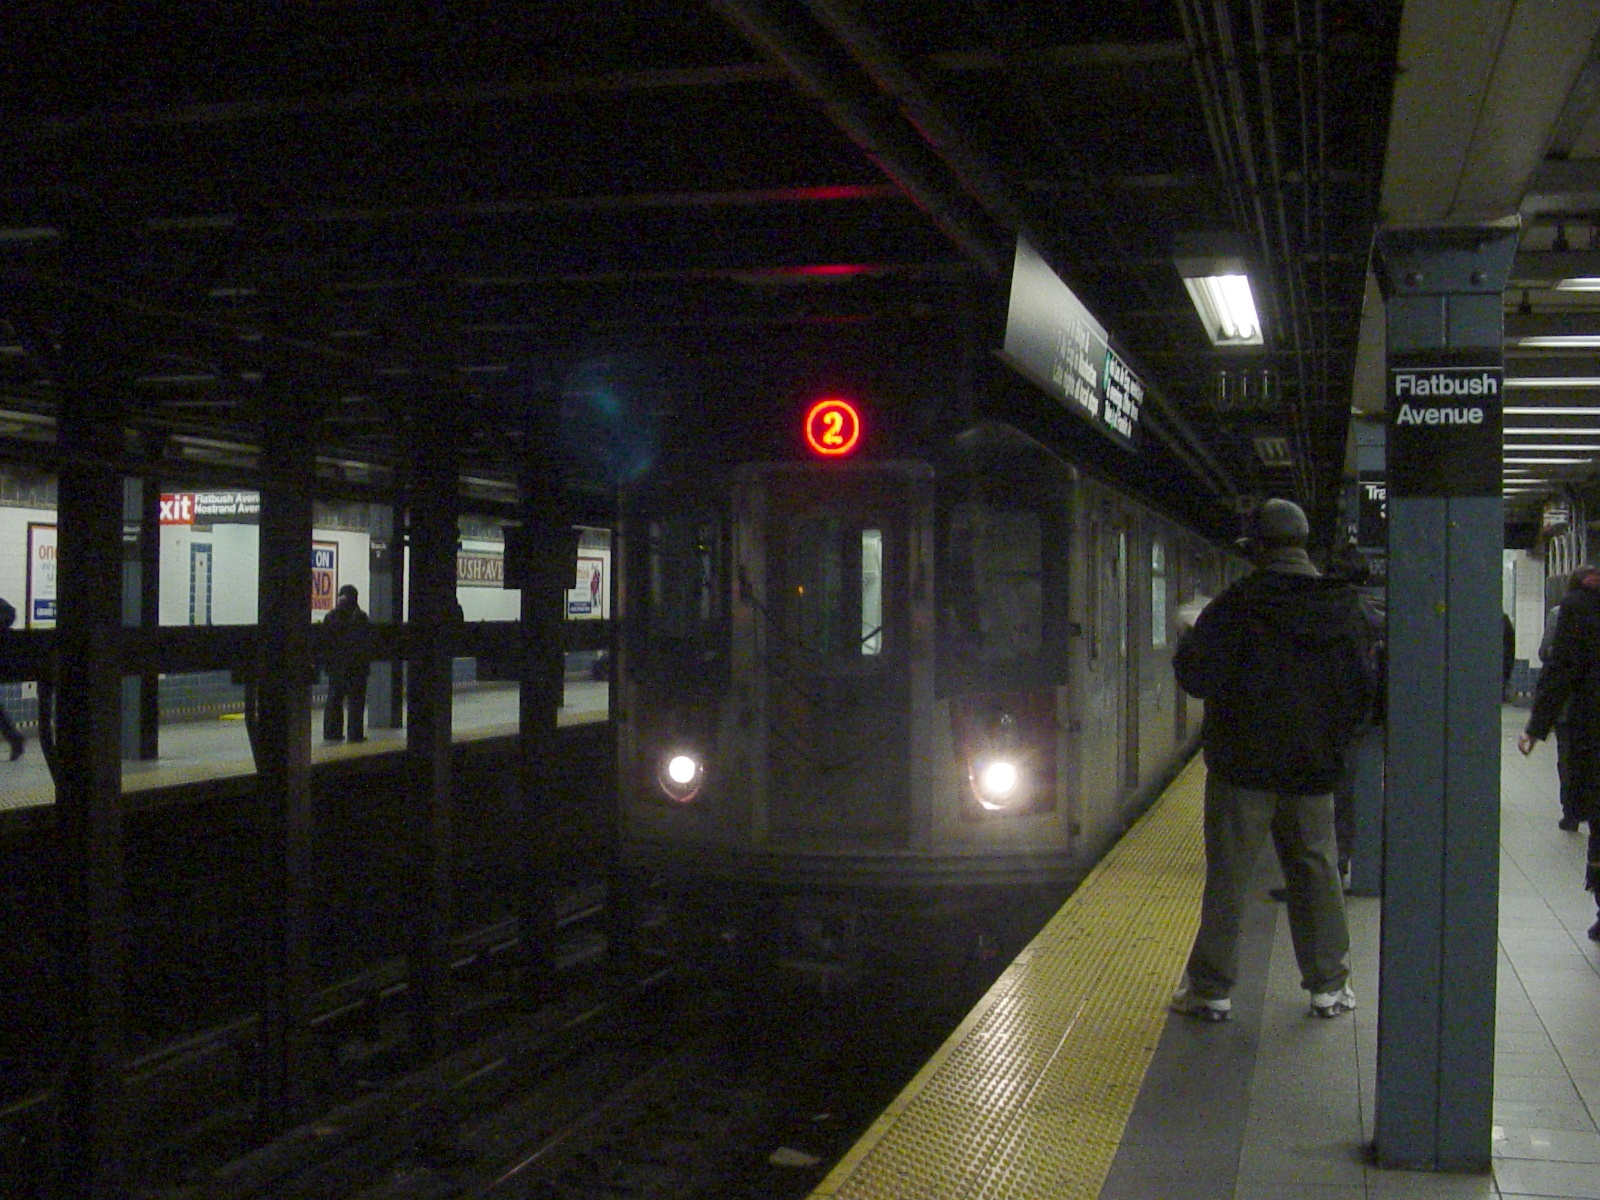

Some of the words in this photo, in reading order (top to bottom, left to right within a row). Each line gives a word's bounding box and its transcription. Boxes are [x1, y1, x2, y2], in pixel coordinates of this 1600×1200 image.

[1395, 373, 1498, 397] Flatbush
[1396, 403, 1484, 425] Avenue
[823, 411, 843, 445] 2
[195, 493, 233, 503] Flatbush
[236, 492, 260, 503] Aven
[1365, 485, 1386, 500] Tra
[160, 494, 191, 520] xit
[195, 504, 236, 514] Nostrand
[238, 503, 260, 514] Aven
[458, 558, 482, 579] USH
